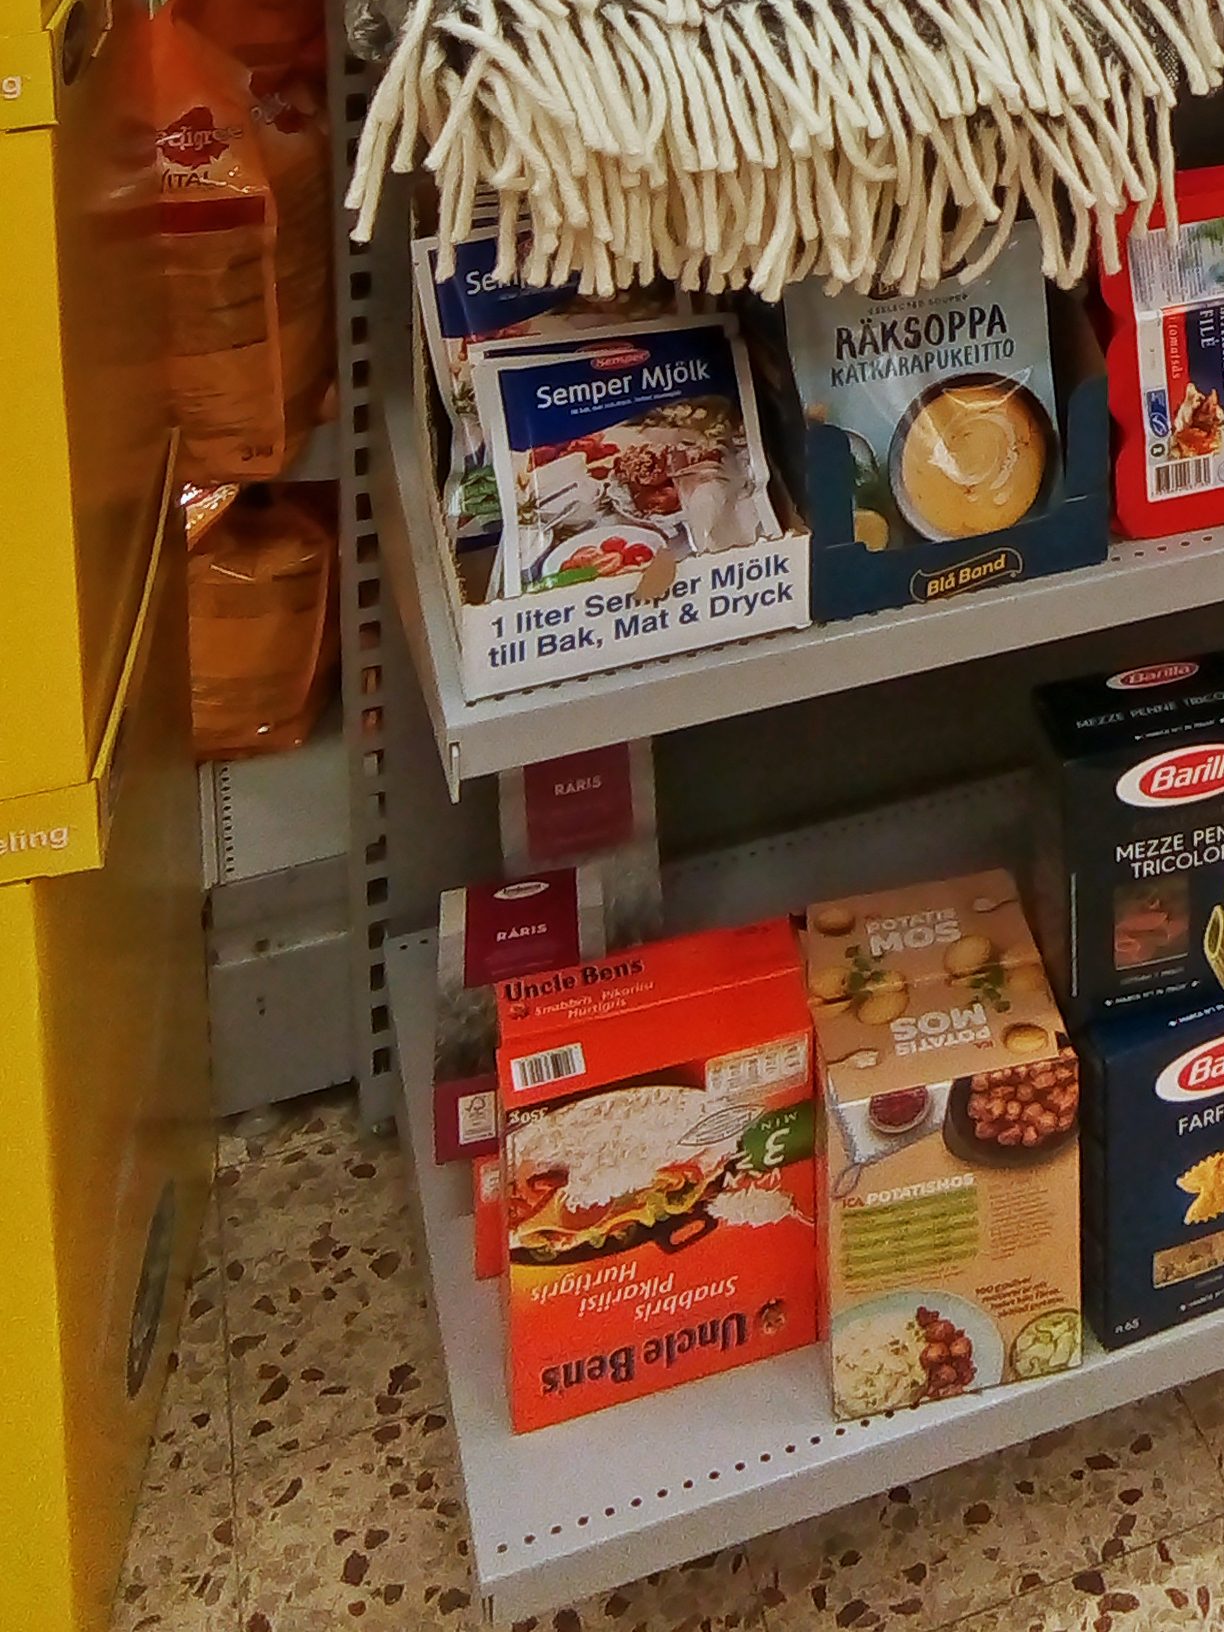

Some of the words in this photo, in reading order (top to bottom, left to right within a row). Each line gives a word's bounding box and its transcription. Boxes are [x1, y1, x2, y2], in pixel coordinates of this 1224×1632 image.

[835, 303, 1008, 362] RÄKSOPPA
[536, 372, 633, 411] Semper
[641, 358, 711, 392] Mjölk
[830, 336, 1016, 388] KATKARAPUKEITTO
[490, 615, 503, 637] 1
[516, 600, 576, 634] liter
[710, 553, 790, 594] Mjölk
[926, 576, 956, 599] Blå
[958, 553, 1007, 585] Band
[488, 645, 526, 668] till
[536, 626, 603, 658] Bak,
[614, 609, 671, 642] Mat
[678, 605, 699, 626] &
[708, 581, 794, 623] Dryck
[1115, 831, 1185, 863] MEZZE
[869, 920, 962, 958] MOS
[504, 970, 577, 1002] Uncle
[889, 1001, 987, 1043] MOS
[760, 1109, 799, 1131] MIN
[762, 1127, 791, 1166] 3
[866, 1173, 976, 1206] POTATISMOS
[530, 1260, 638, 1304] Hurtigris
[577, 1271, 676, 1319] Pikariisi
[633, 1274, 738, 1323] Snabbris
[642, 1310, 748, 1366] Uncle
